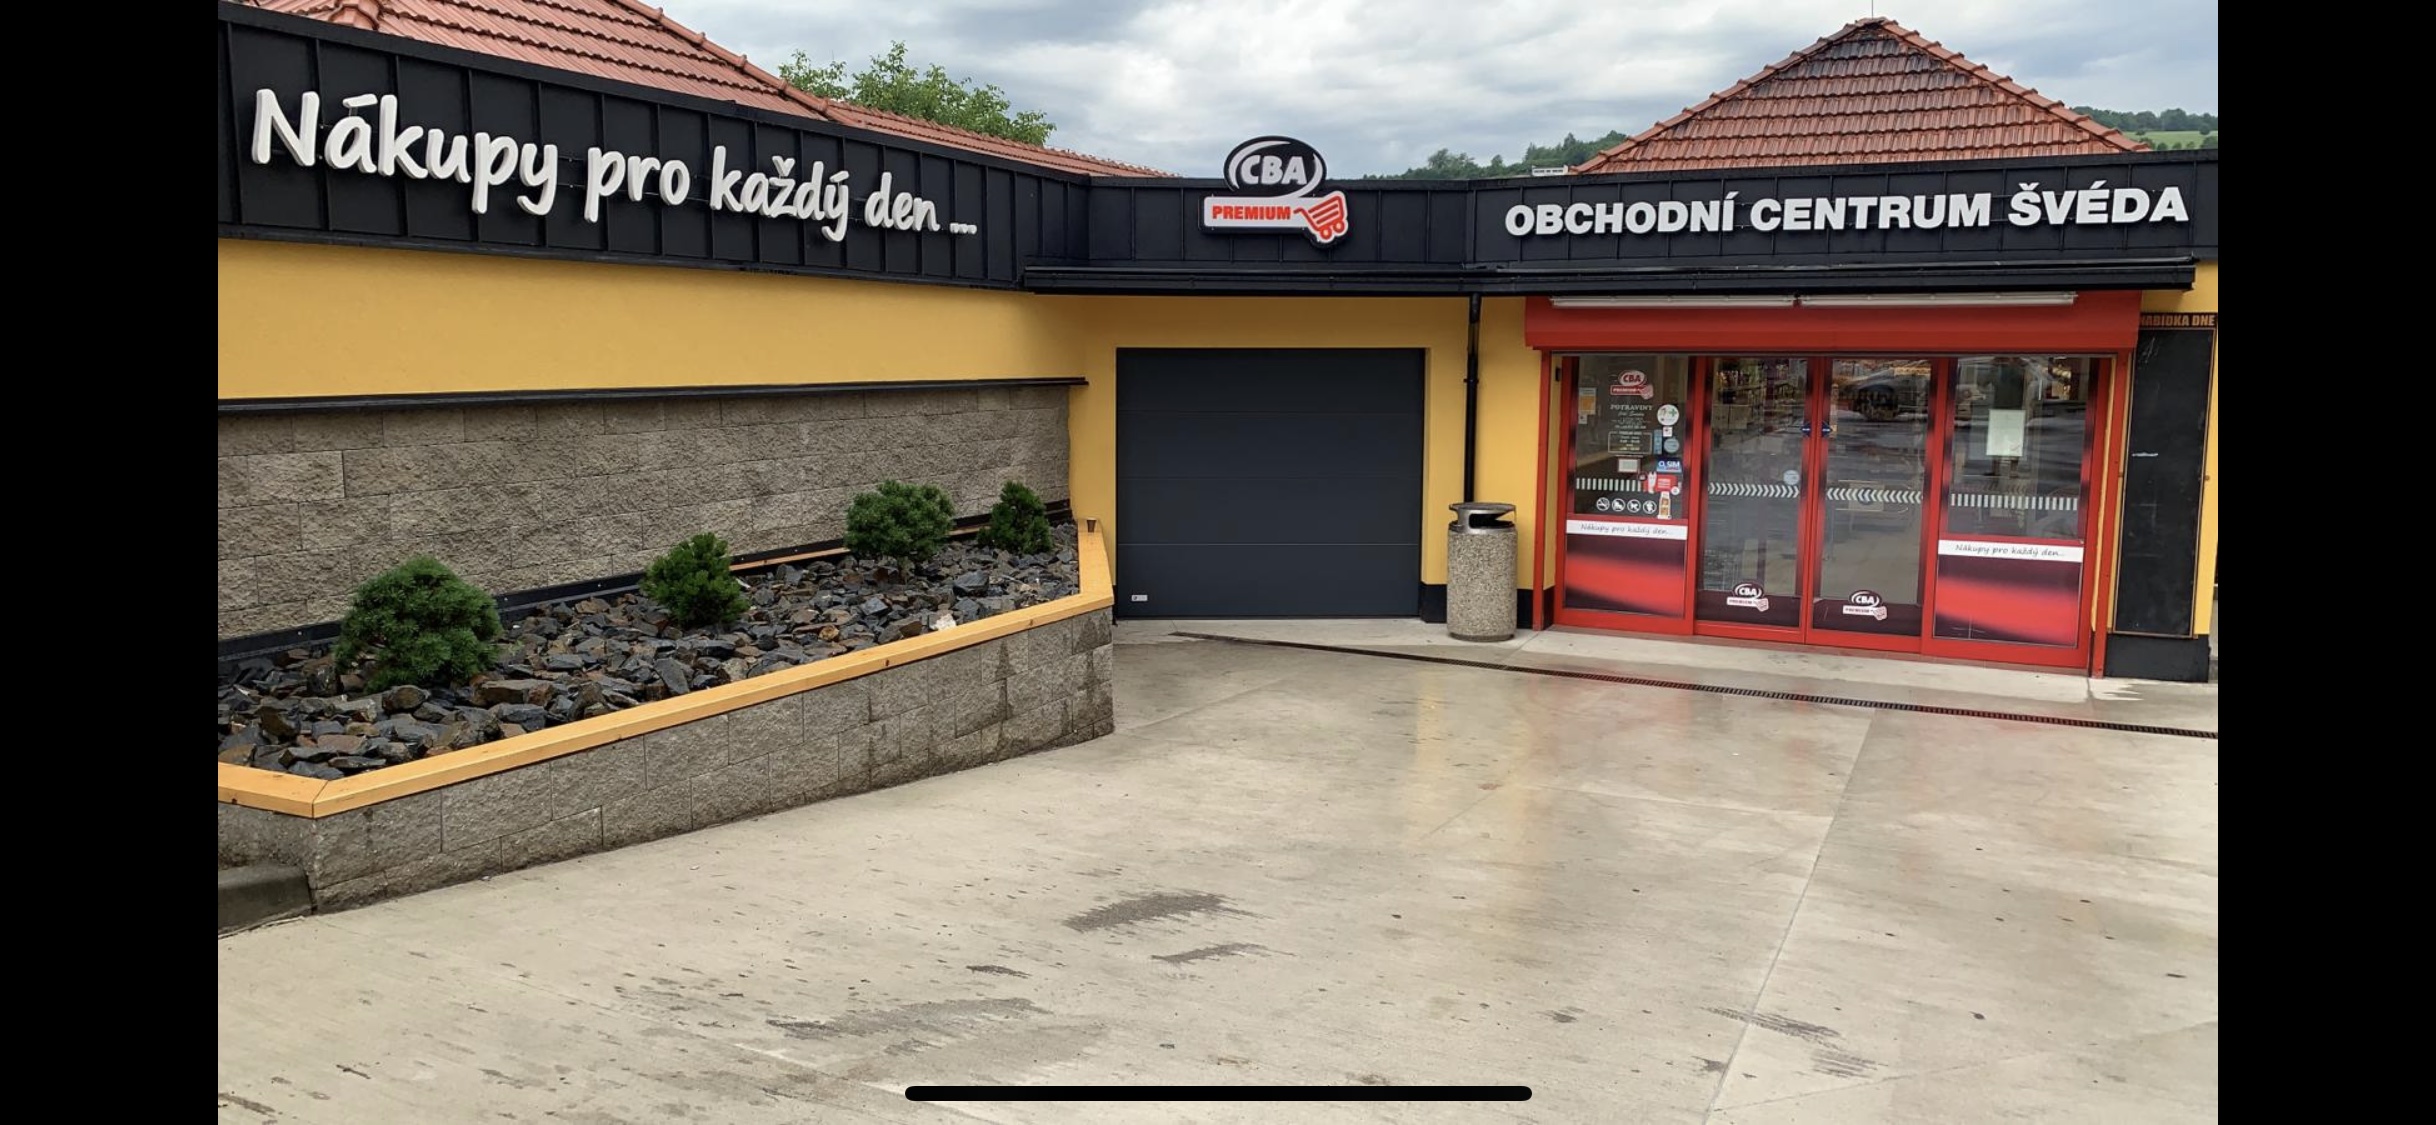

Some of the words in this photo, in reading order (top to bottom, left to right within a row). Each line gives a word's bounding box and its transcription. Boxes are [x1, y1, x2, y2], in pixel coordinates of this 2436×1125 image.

[252, 88, 558, 215] Nákupy
[584, 146, 690, 223] pro
[709, 145, 849, 242] každý
[864, 172, 941, 232] den
[1240, 154, 1308, 186] CBA
[1212, 205, 1291, 220] PREMIUM
[1505, 190, 1740, 236] OBCHODNÍ
[1750, 193, 1992, 231] CENTRUM
[2008, 180, 2190, 226] ŠVÉDA
[2192, 314, 2215, 326] DNE
[1622, 374, 1641, 383] CBA
[1955, 544, 1989, 554] Nákupy
[1738, 587, 1757, 596] CBA
[1855, 596, 1875, 604] CBA
